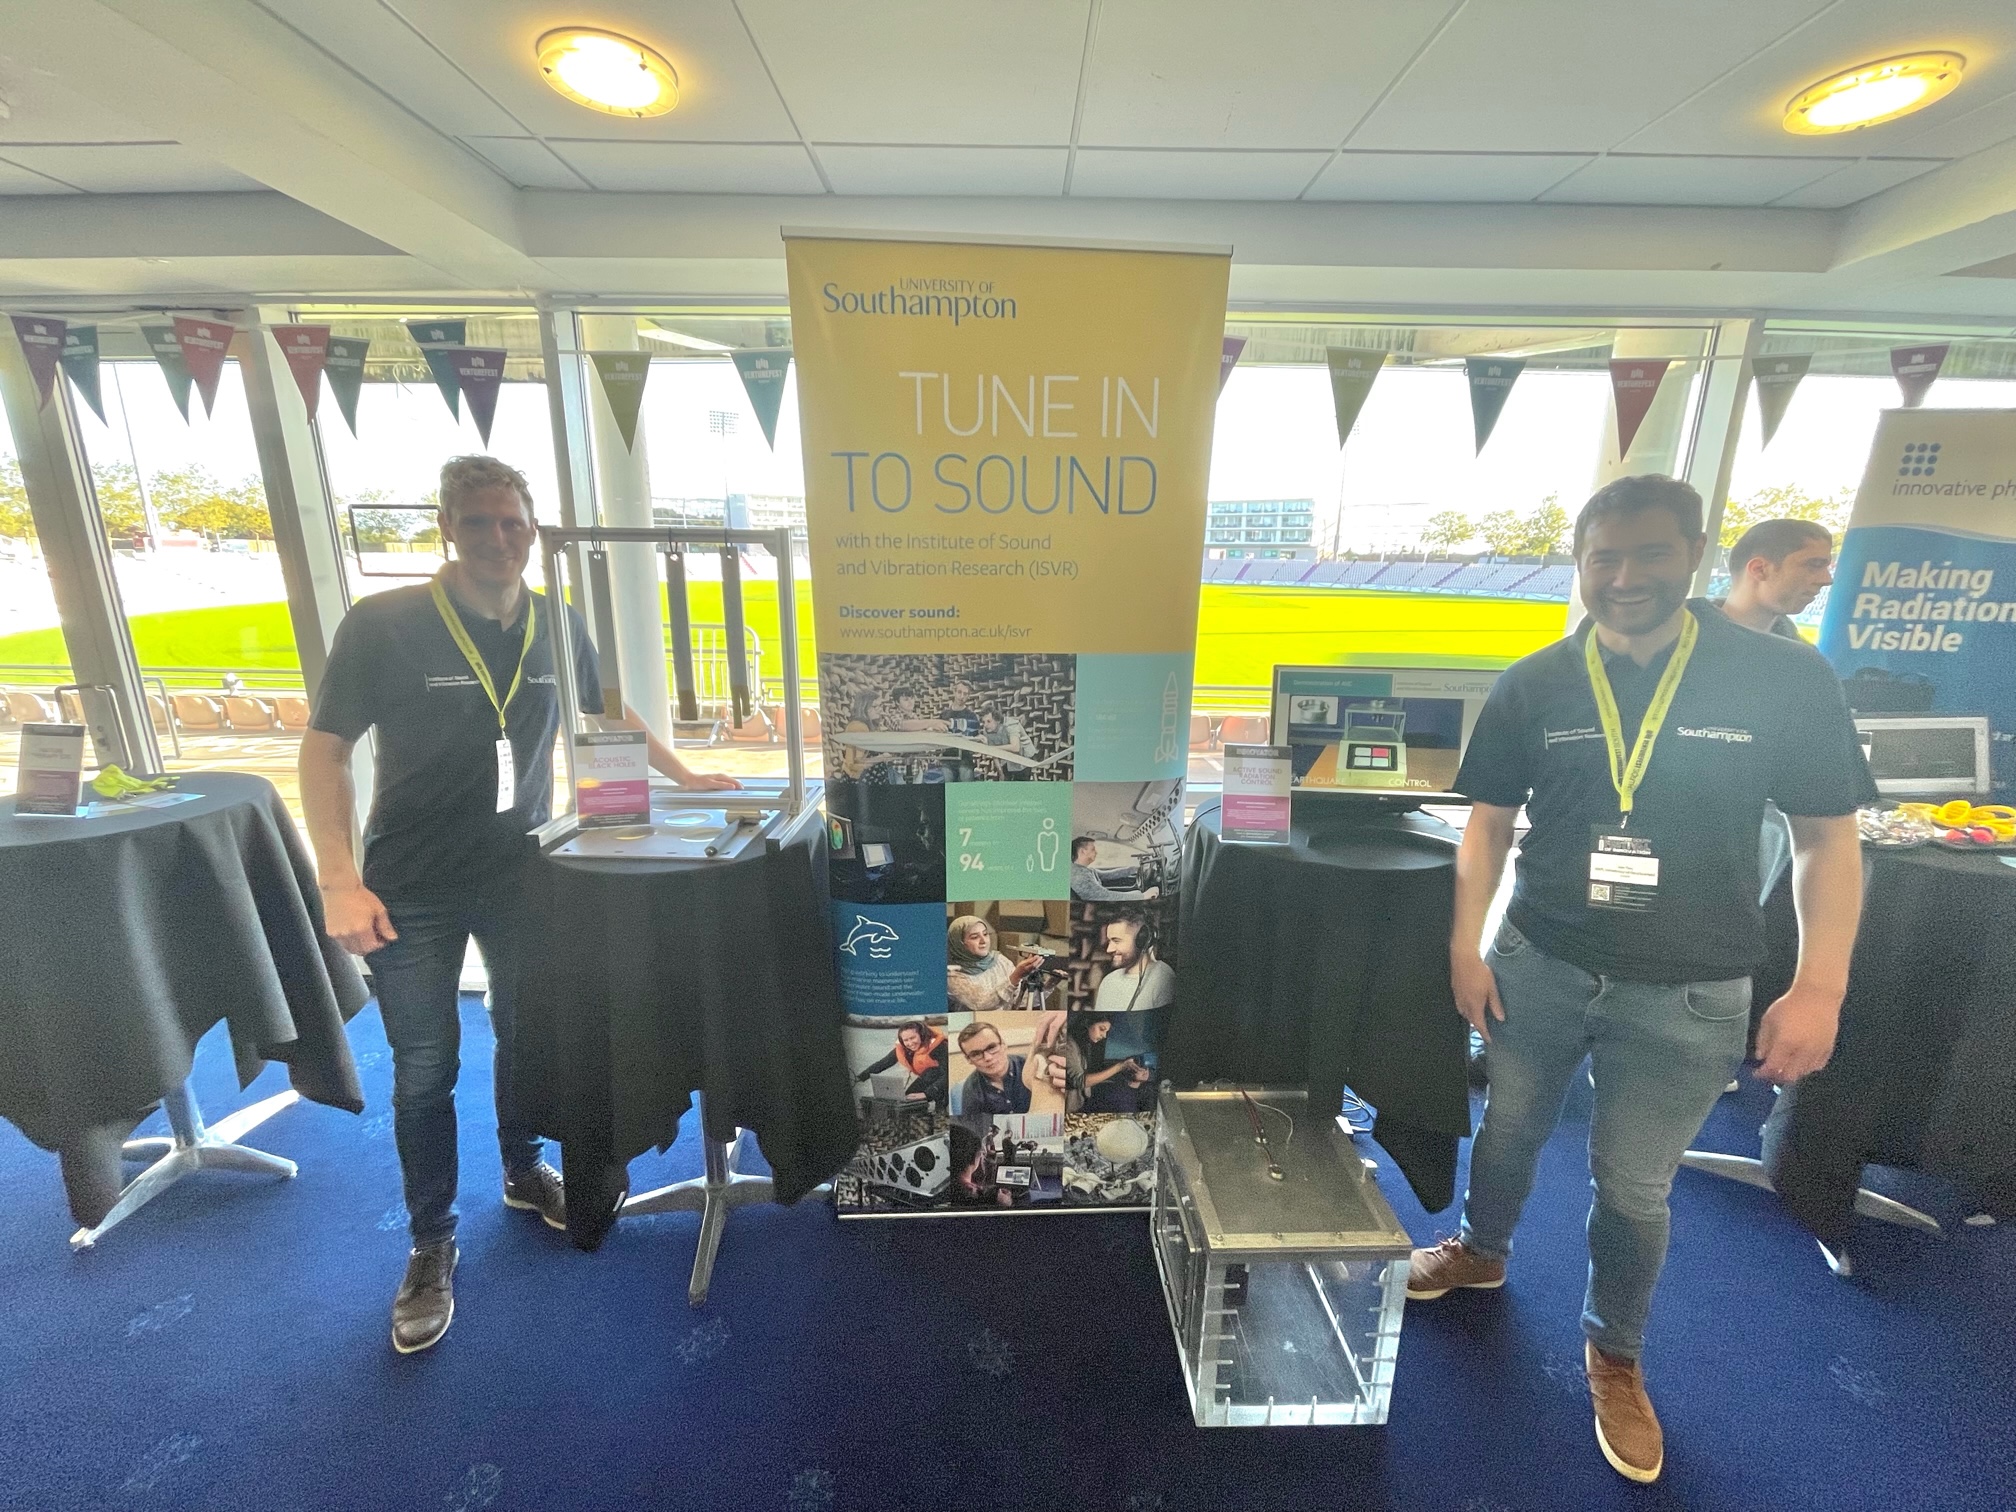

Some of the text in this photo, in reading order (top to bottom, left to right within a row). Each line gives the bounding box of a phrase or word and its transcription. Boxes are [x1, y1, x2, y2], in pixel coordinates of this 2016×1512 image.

[900, 277, 995, 294] UNIVERSITY OF
[823, 281, 1017, 326] Southampton
[1222, 354, 1233, 364] EST
[899, 371, 1159, 438] TUNE IN
[831, 452, 1158, 515] TO SOUND
[1892, 479, 1987, 497] innovative
[836, 532, 1052, 551] with the Institute of Sound
[836, 559, 1079, 581] and Vibration Research (ISVR)
[1861, 561, 1993, 598] Making
[839, 606, 960, 619] Discover sound:
[1853, 592, 2016, 622] Radiation
[840, 623, 1032, 641] www.southampton.ac.uk/isvr
[1848, 623, 1963, 652] Visible
[1443, 683, 1494, 695] Southampto
[1677, 726, 1753, 743] Southampton
[593, 755, 631, 764] ACOUSTIC
[613, 761, 636, 769] HOLES
[1232, 766, 1283, 775] ACTIVE SOUND
[1239, 773, 1276, 781] RADIATION
[1241, 778, 1273, 786] CONTROL
[1388, 778, 1432, 788] CONTROL
[959, 827, 972, 847] 7
[959, 852, 985, 872] 94
